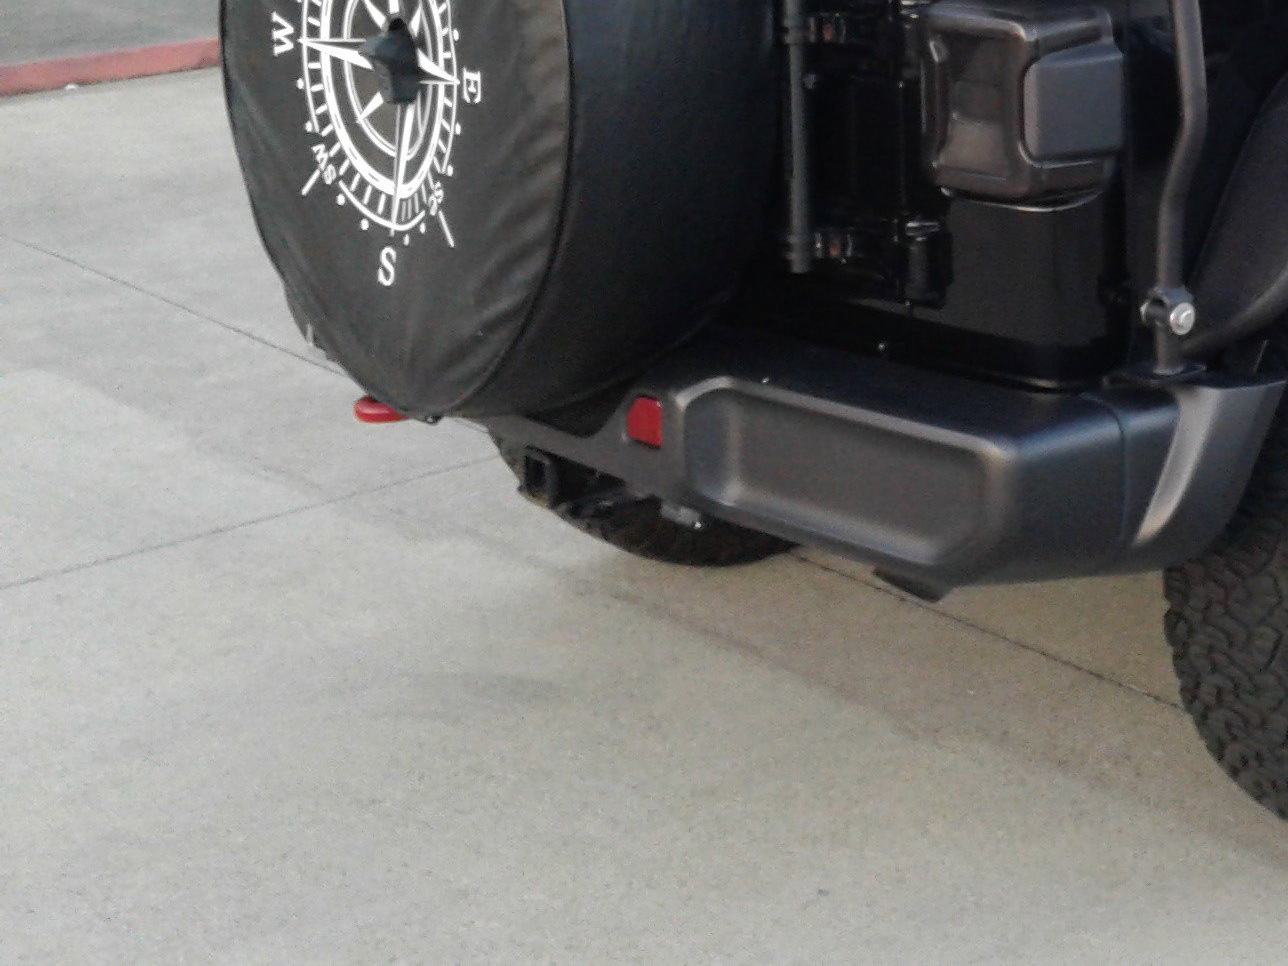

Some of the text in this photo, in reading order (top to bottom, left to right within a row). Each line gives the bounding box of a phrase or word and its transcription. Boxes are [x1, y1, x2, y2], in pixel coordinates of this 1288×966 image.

[272, 12, 294, 55] W
[463, 70, 481, 105] E
[378, 246, 397, 286] S
